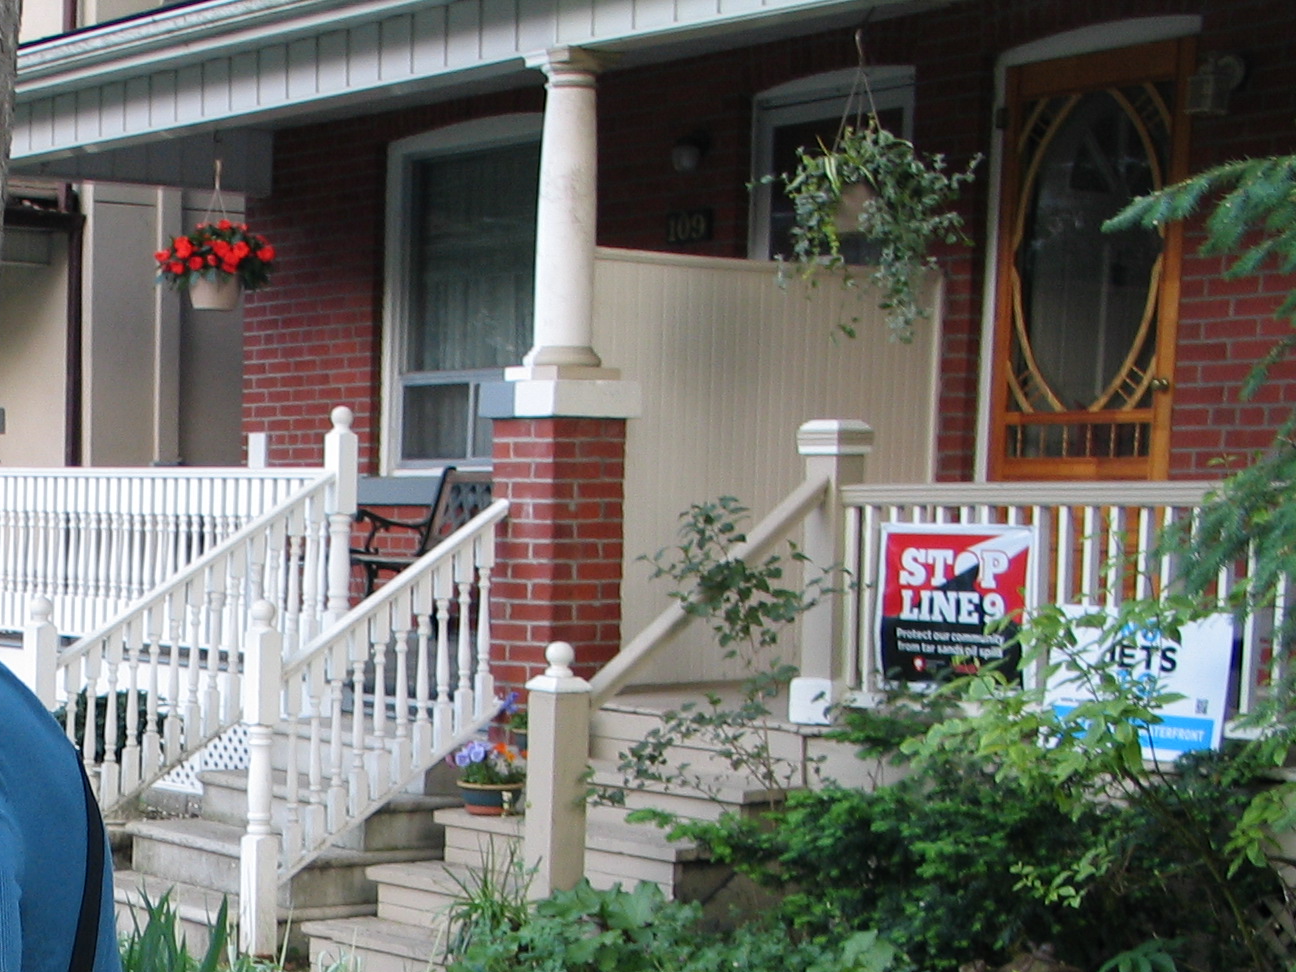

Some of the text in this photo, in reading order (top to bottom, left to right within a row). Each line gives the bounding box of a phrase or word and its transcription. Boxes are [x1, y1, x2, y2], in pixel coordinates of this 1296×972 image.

[668, 213, 705, 242] 109
[899, 547, 1009, 589] STOP
[896, 627, 1003, 647] Protect our community
[898, 640, 920, 651] from
[921, 642, 936, 654] tar
[936, 644, 964, 656] sands
